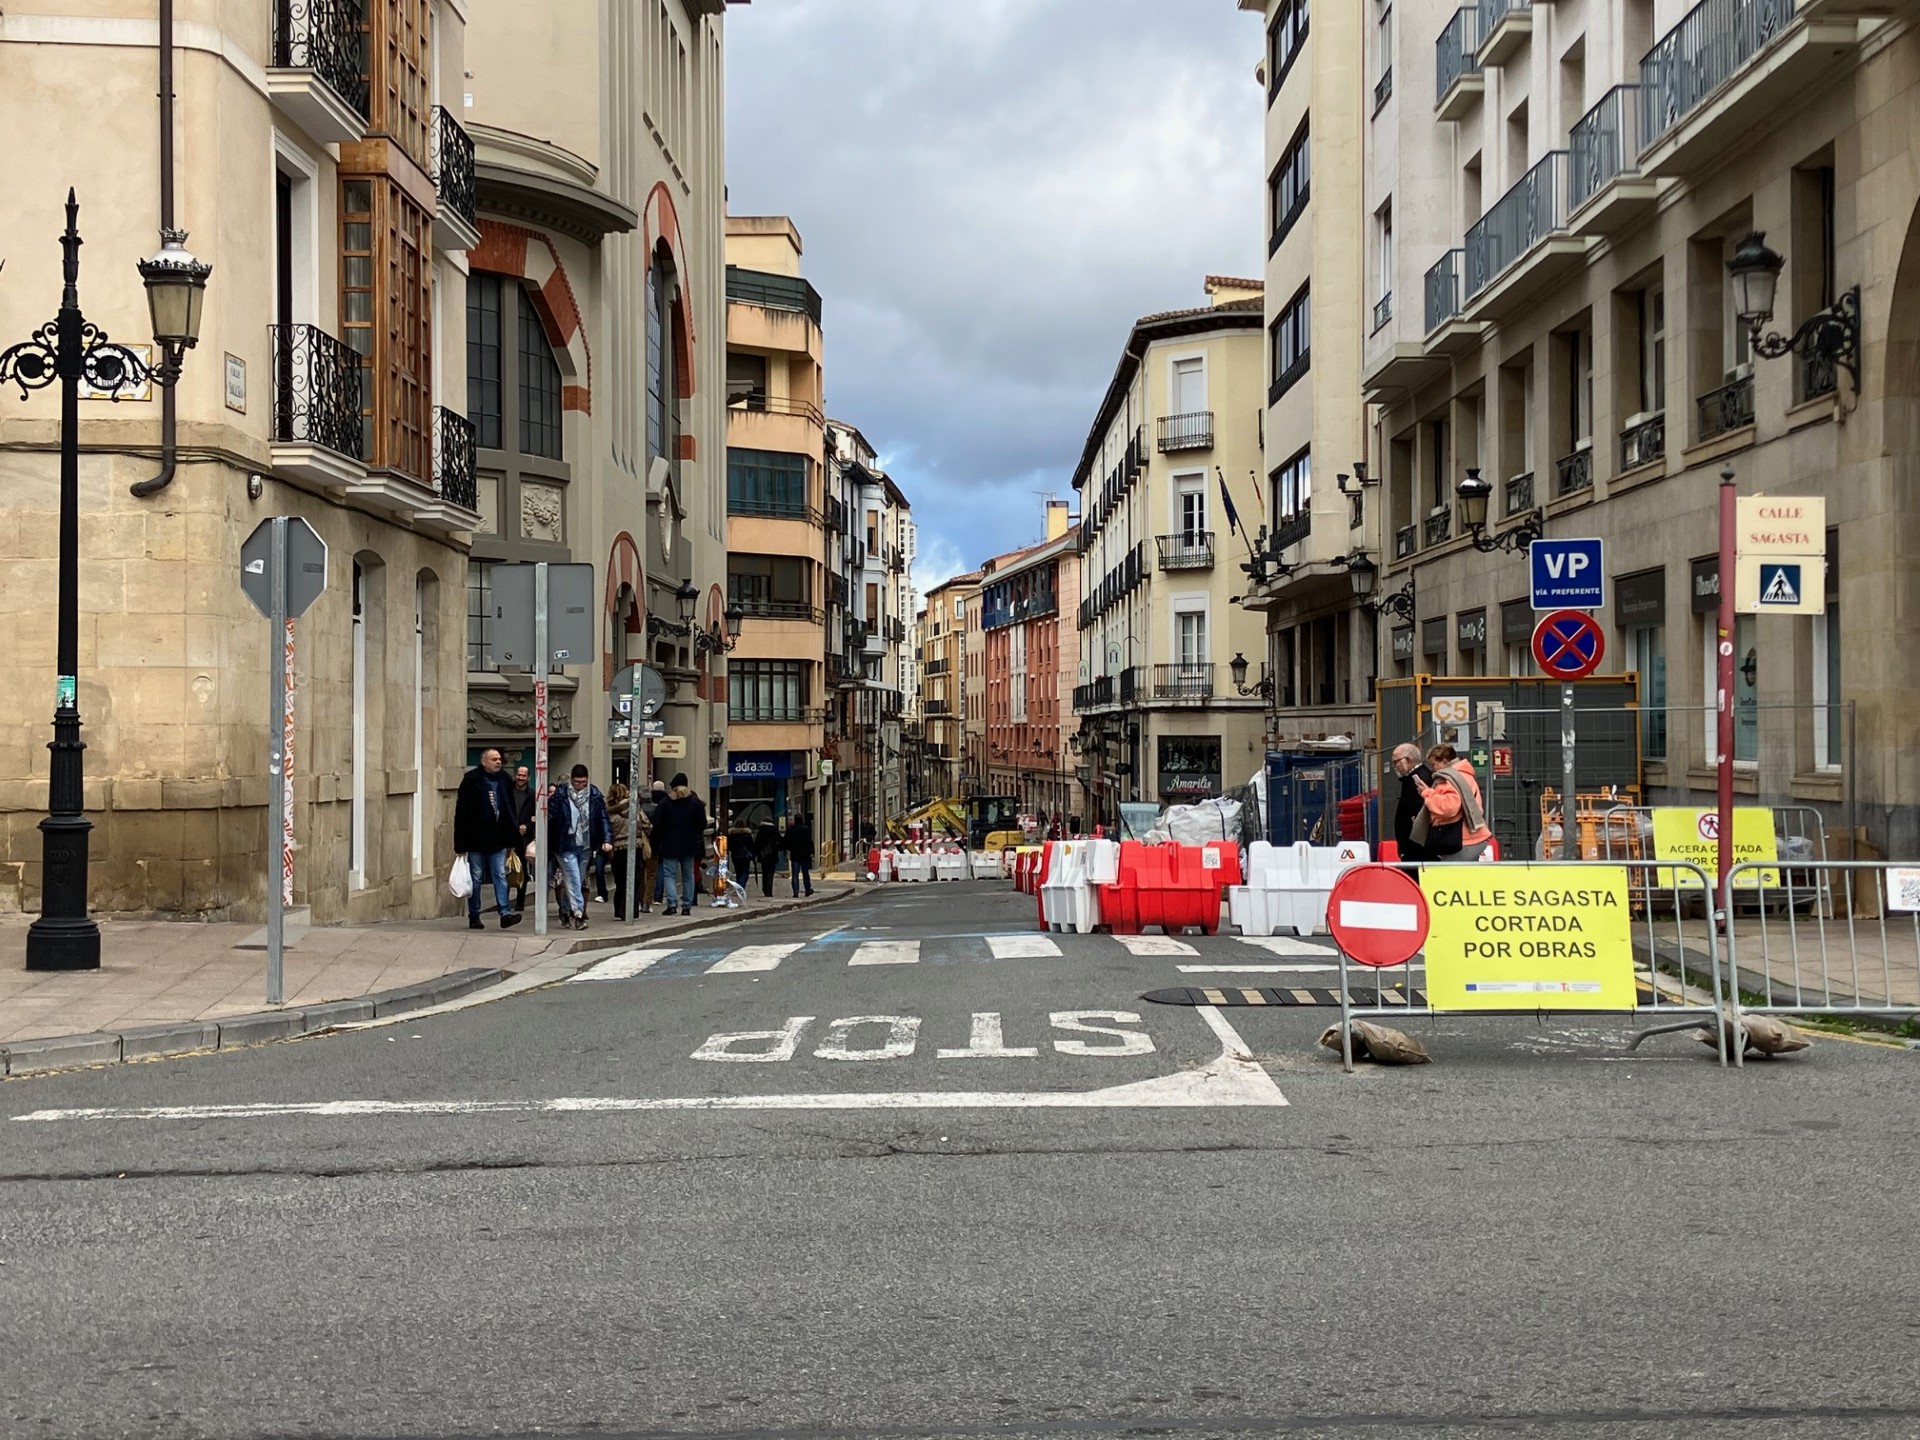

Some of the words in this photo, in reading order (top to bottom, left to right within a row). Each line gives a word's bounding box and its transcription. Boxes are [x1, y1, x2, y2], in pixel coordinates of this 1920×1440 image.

[1759, 507, 1803, 519] CALLE
[1750, 533, 1809, 544] SAGASTA
[1544, 552, 1589, 579] VP
[1551, 587, 1601, 596] PREFERENTE
[1434, 700, 1467, 721] C5
[735, 760, 773, 772] adra360
[1669, 845, 1707, 853] ACERA
[1710, 845, 1763, 853] CTADA
[1685, 857, 1708, 866] POR
[1433, 890, 1507, 907] CALLE
[1513, 890, 1618, 907] SAGASTA
[1475, 916, 1583, 932] CORTADA
[1464, 942, 1512, 958] POR
[1519, 942, 1596, 958] OBRAS
[689, 1009, 1157, 1062] STOP
